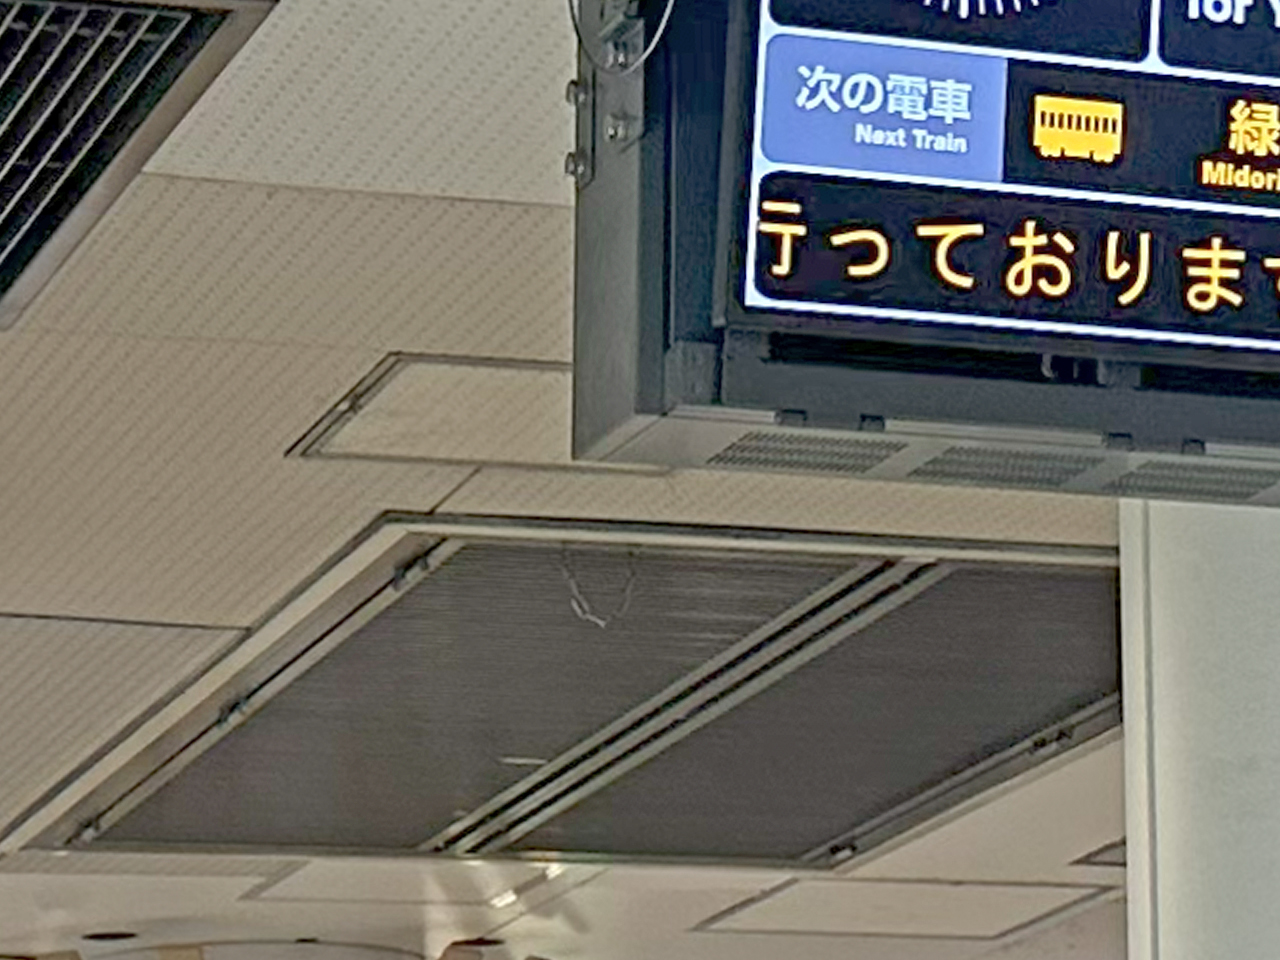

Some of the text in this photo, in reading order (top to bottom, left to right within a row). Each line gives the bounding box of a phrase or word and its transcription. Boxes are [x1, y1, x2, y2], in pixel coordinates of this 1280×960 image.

[795, 65, 973, 125] 次の電車
[854, 122, 968, 154] Next Train
